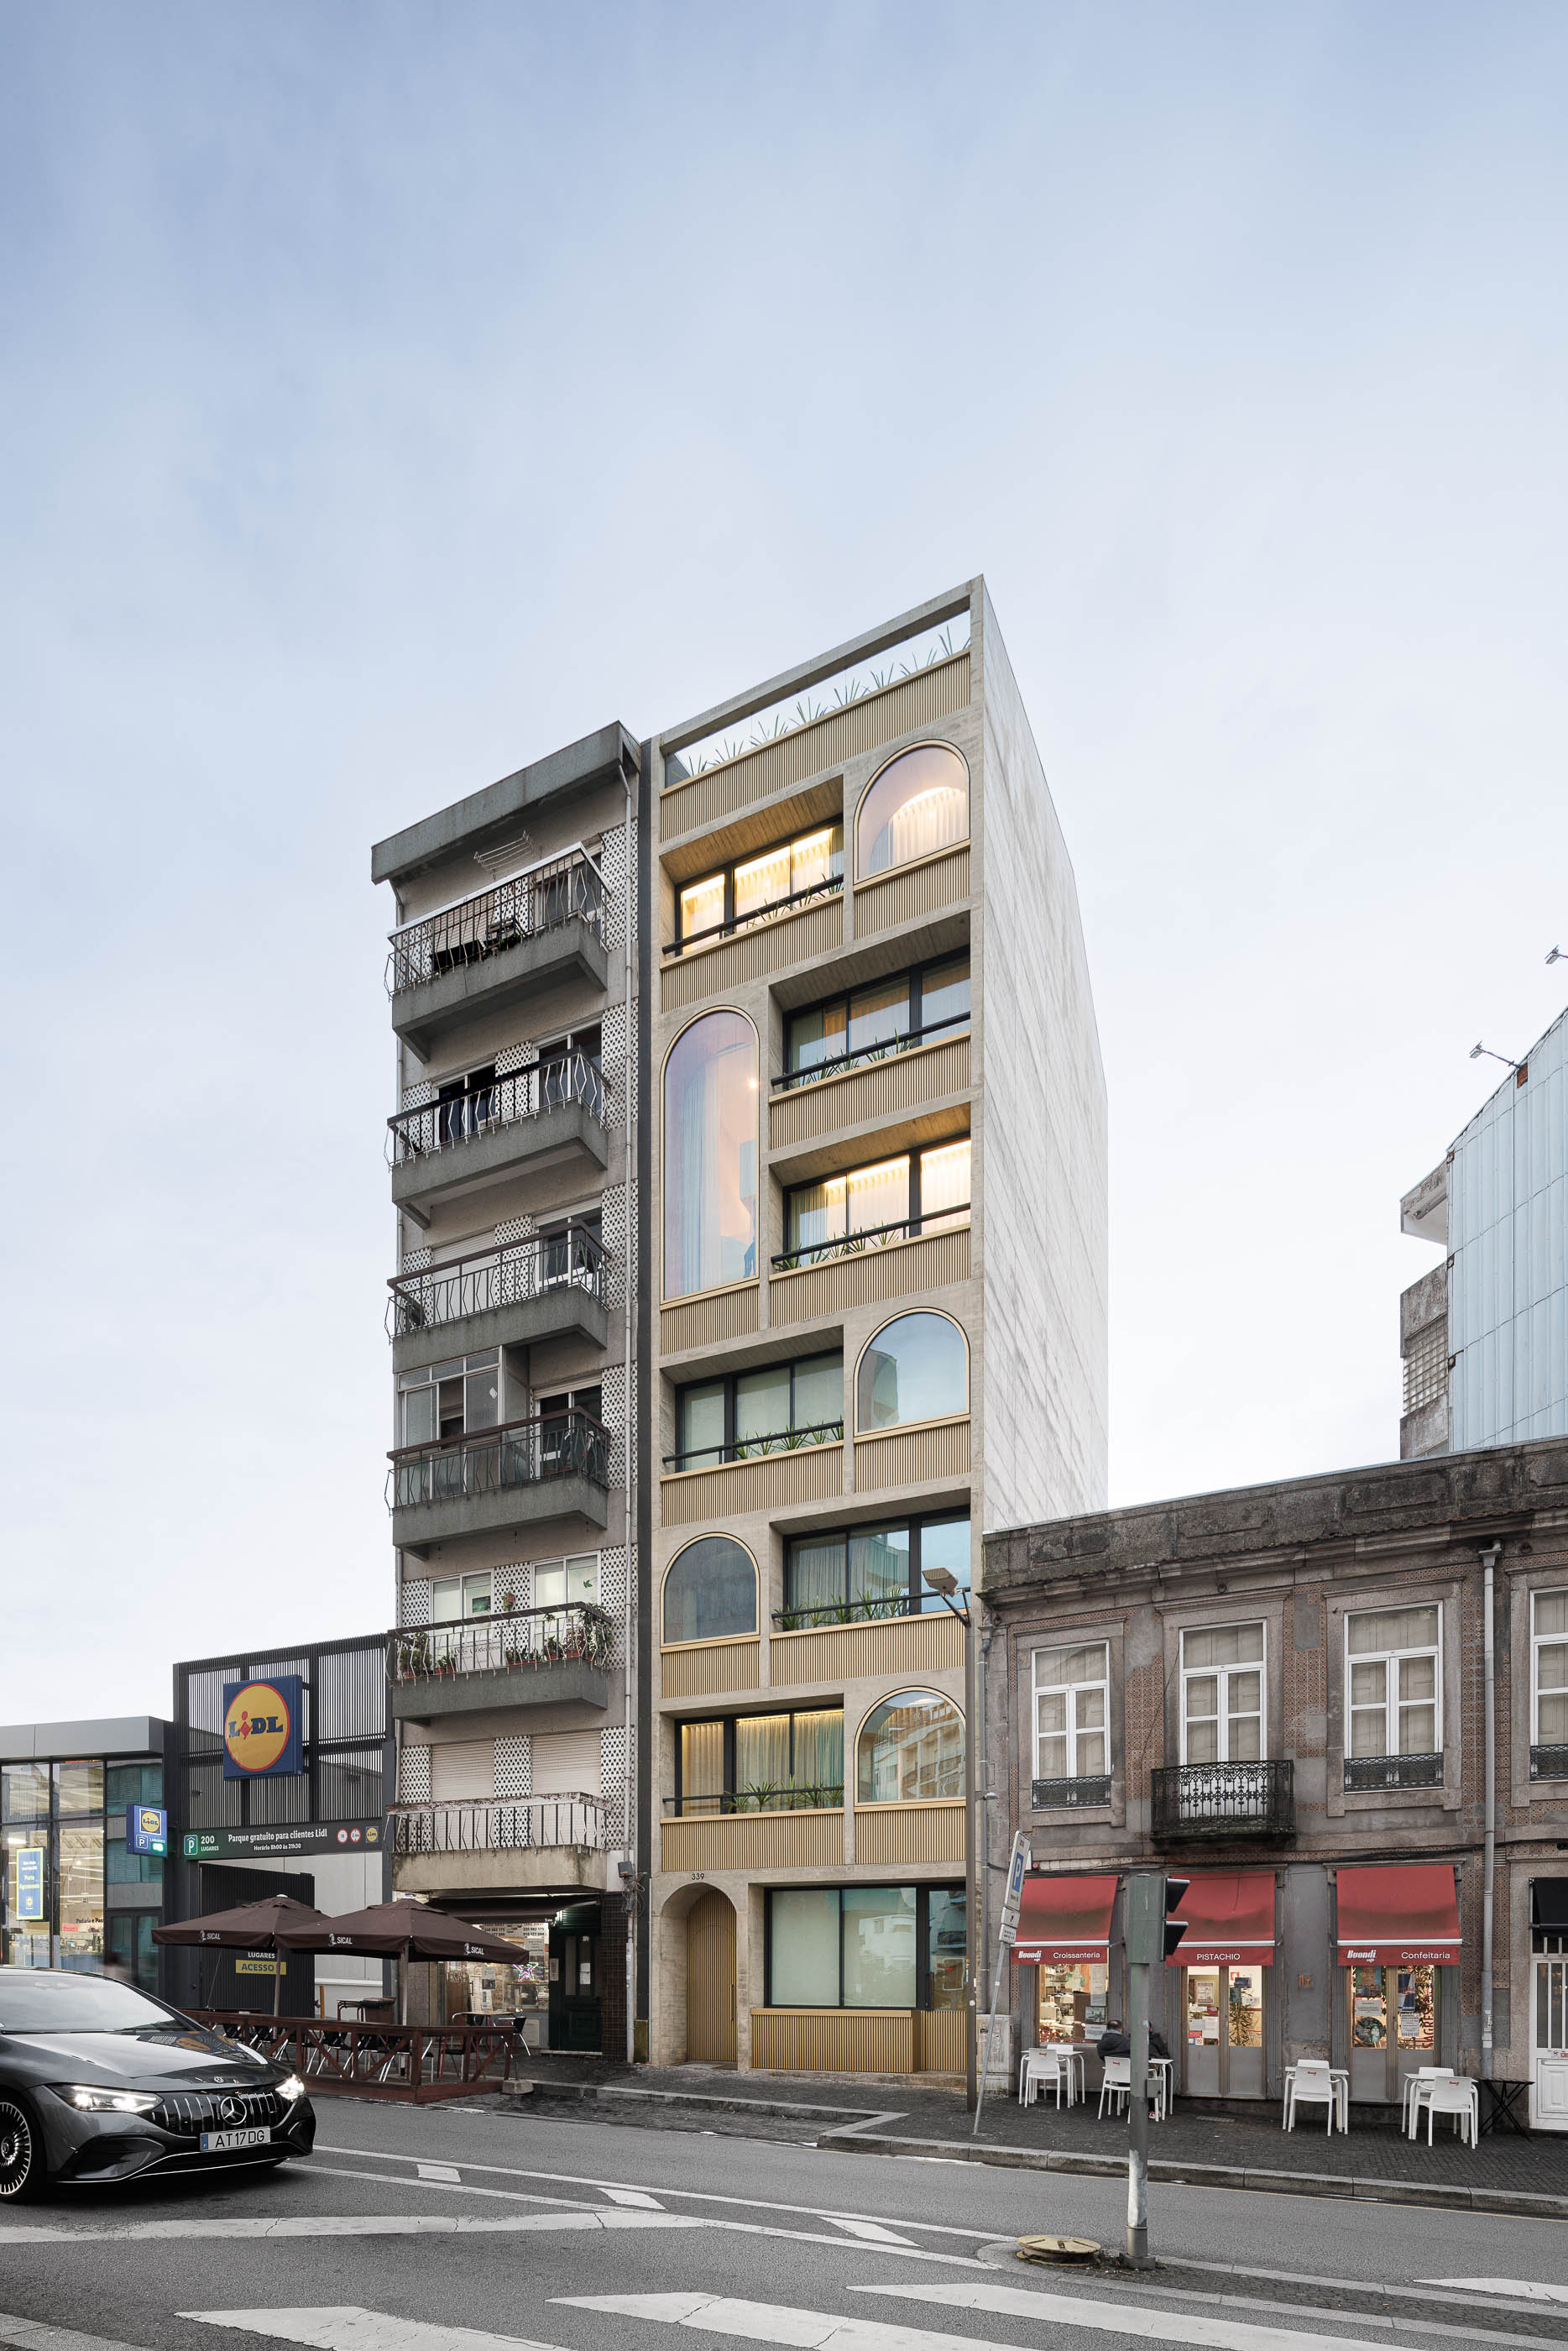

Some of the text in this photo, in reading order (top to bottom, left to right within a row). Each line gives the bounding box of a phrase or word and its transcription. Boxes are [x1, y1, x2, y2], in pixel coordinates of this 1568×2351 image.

[201, 1835, 215, 1845] 200
[227, 1828, 327, 1843] Parque gratuito para clientes Lidl
[1014, 1857, 1022, 1888] P
[337, 1936, 353, 1945] SICAL
[471, 1946, 484, 1956] SICAL
[1401, 1951, 1450, 1960] Confeitaria
[241, 1963, 274, 1972] ACESSO
